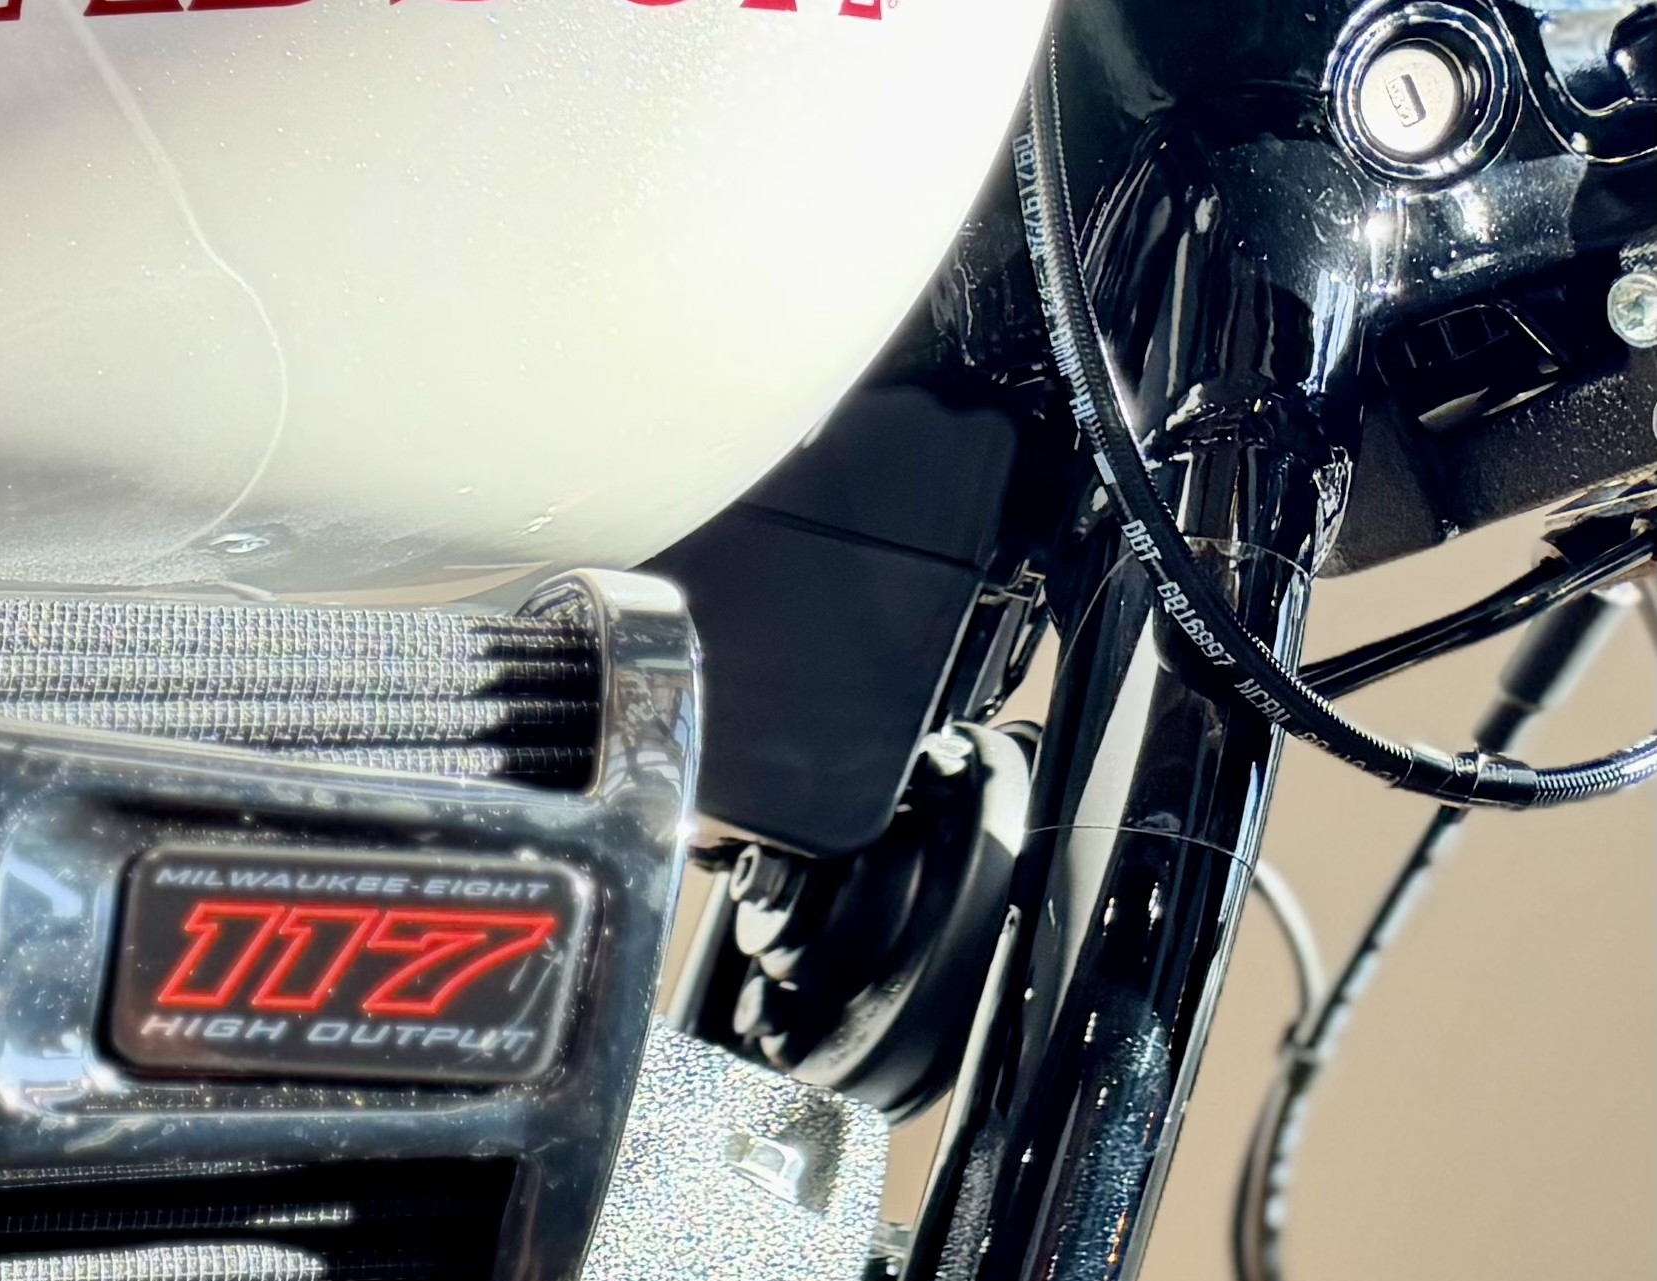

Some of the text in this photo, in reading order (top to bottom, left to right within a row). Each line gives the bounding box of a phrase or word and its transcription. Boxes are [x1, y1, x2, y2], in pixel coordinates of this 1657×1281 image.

[1120, 519, 1162, 561] DOT
[155, 868, 549, 899] MILWAUKEE-EIGHT
[158, 901, 557, 1016] 117
[140, 1014, 536, 1052] HIGH OUTPUT
